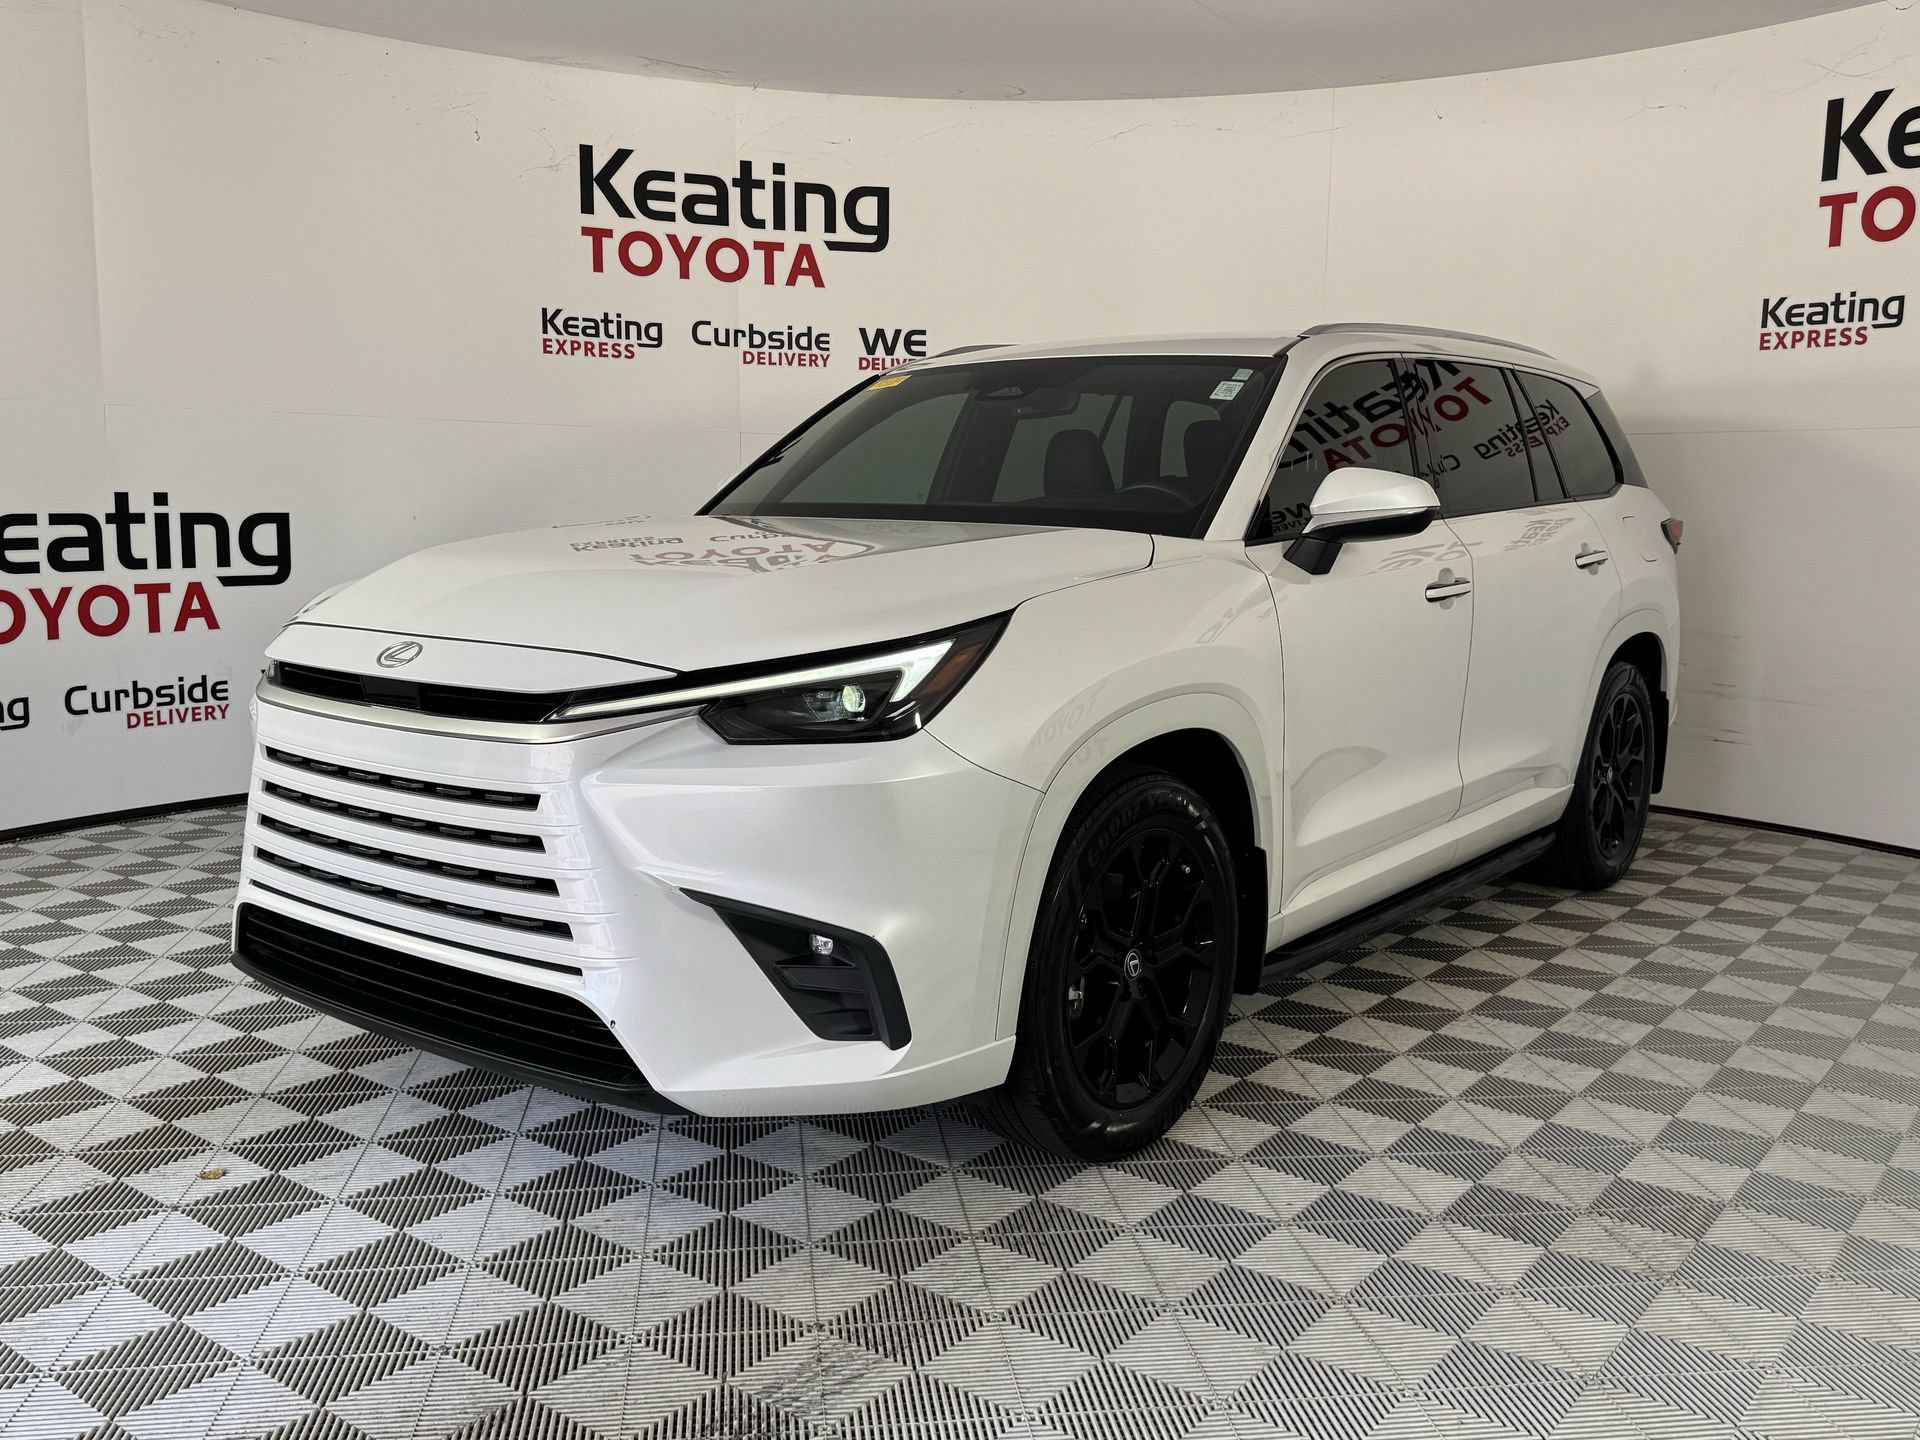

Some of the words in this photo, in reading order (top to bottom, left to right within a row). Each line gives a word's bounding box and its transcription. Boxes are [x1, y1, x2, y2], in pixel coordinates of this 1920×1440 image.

[579, 144, 890, 253] Keating
[1818, 185, 1917, 248] TO
[580, 226, 825, 288] TOYOTA
[1760, 291, 1906, 330] Keating
[541, 307, 663, 349] Keating
[691, 320, 830, 351] Curbside
[858, 327, 927, 357] WE
[1759, 326, 1868, 351] EXPRESS
[542, 338, 636, 360] EXPRESS
[742, 351, 831, 368] DELIVERY
[858, 357, 917, 371] DELIV
[64, 675, 229, 716] Curbside
[127, 704, 230, 729] DELIVERY
